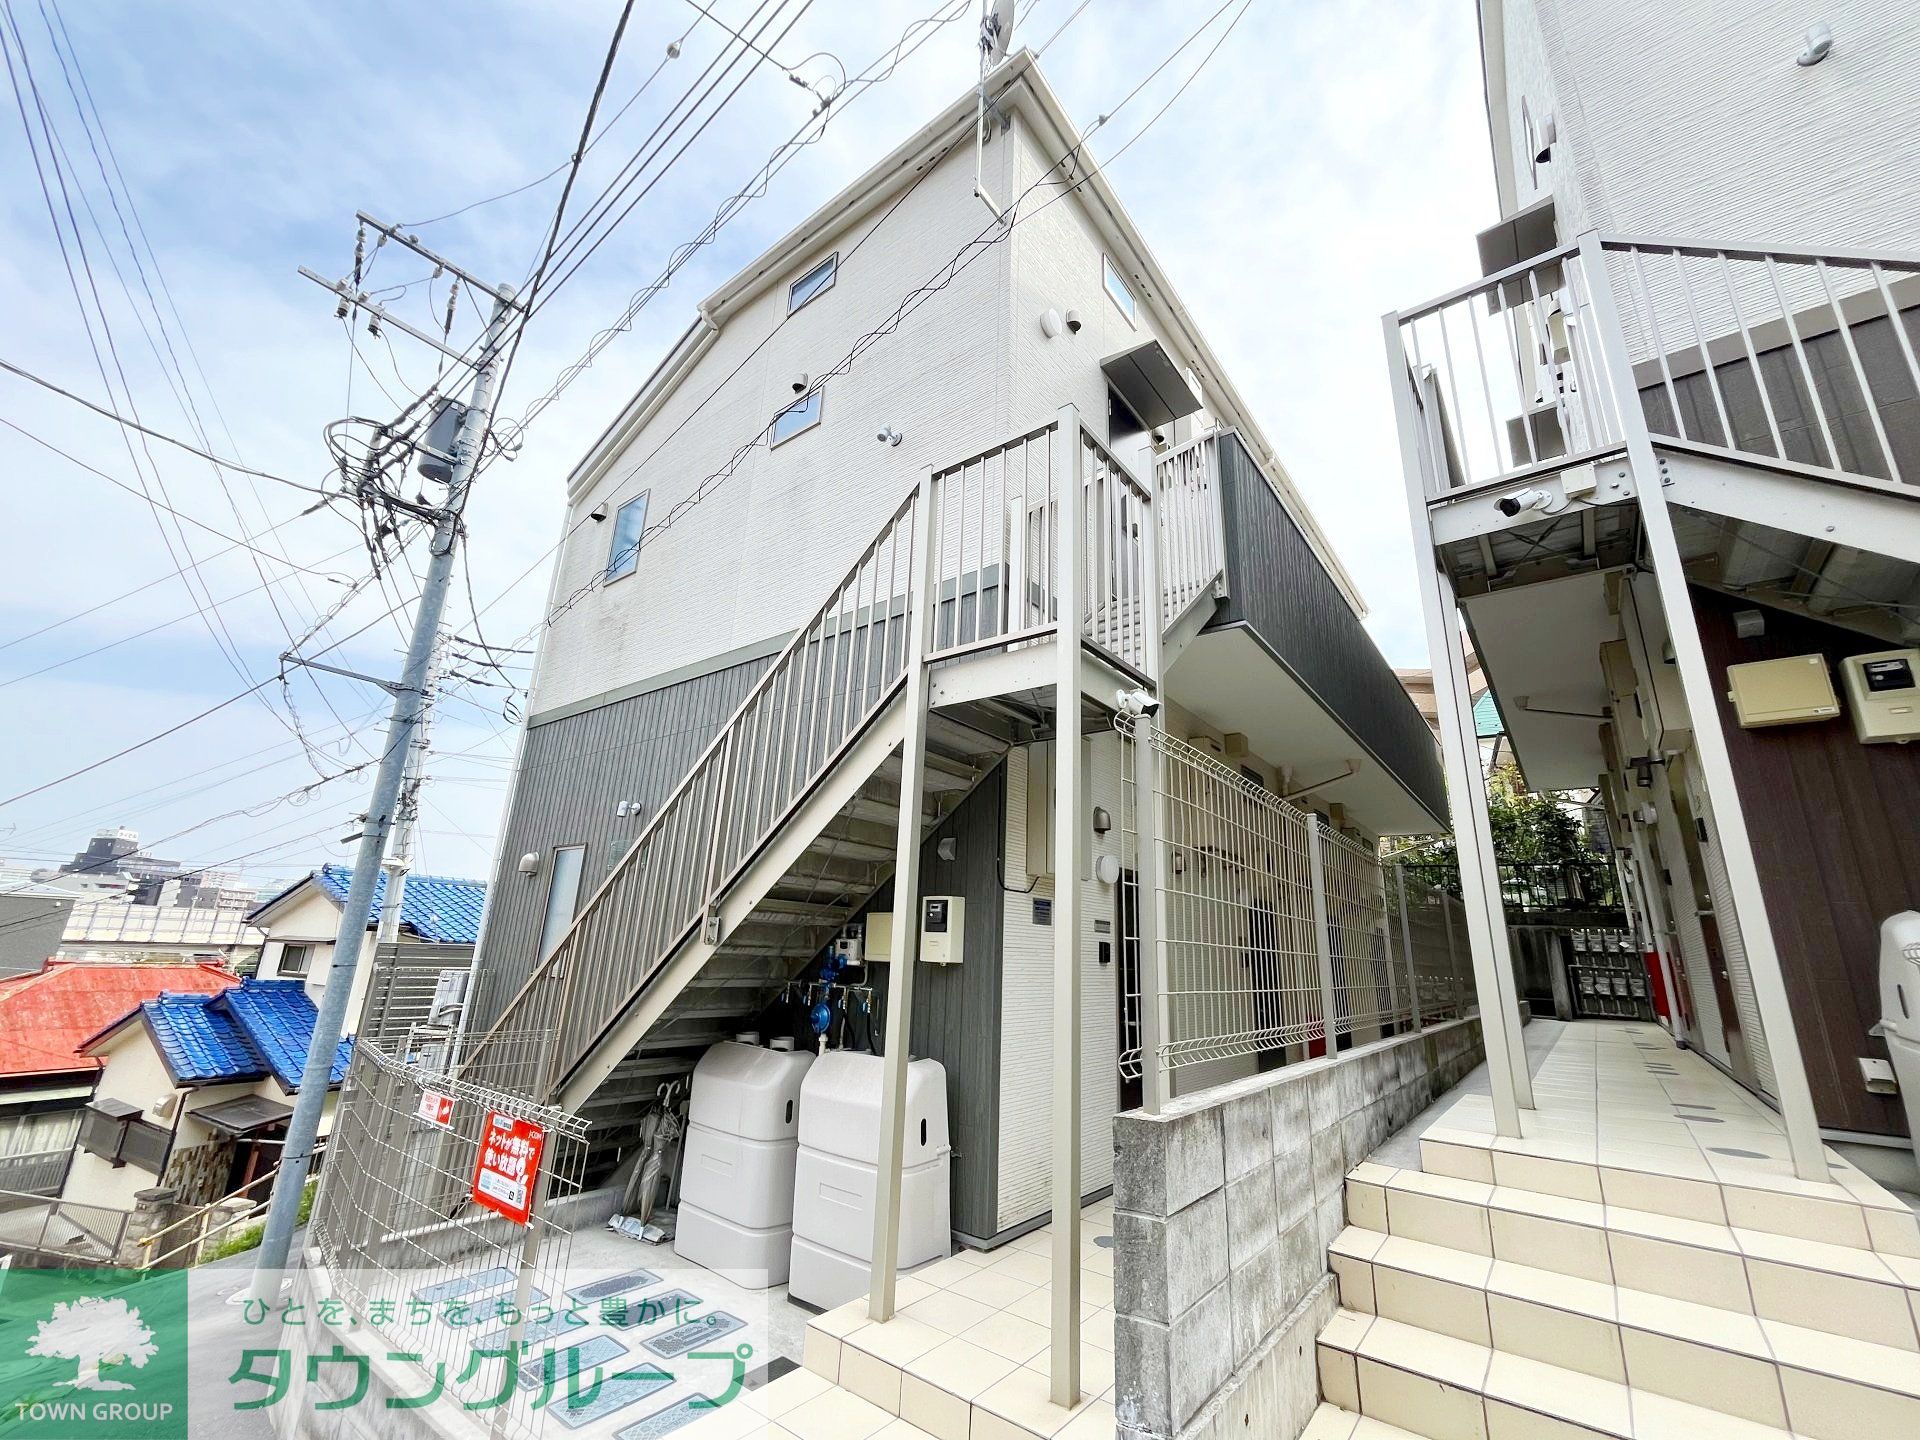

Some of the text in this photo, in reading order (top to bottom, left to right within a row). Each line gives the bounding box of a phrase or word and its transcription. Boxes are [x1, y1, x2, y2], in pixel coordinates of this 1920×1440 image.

[488, 1130, 536, 1160] ネットが無料で
